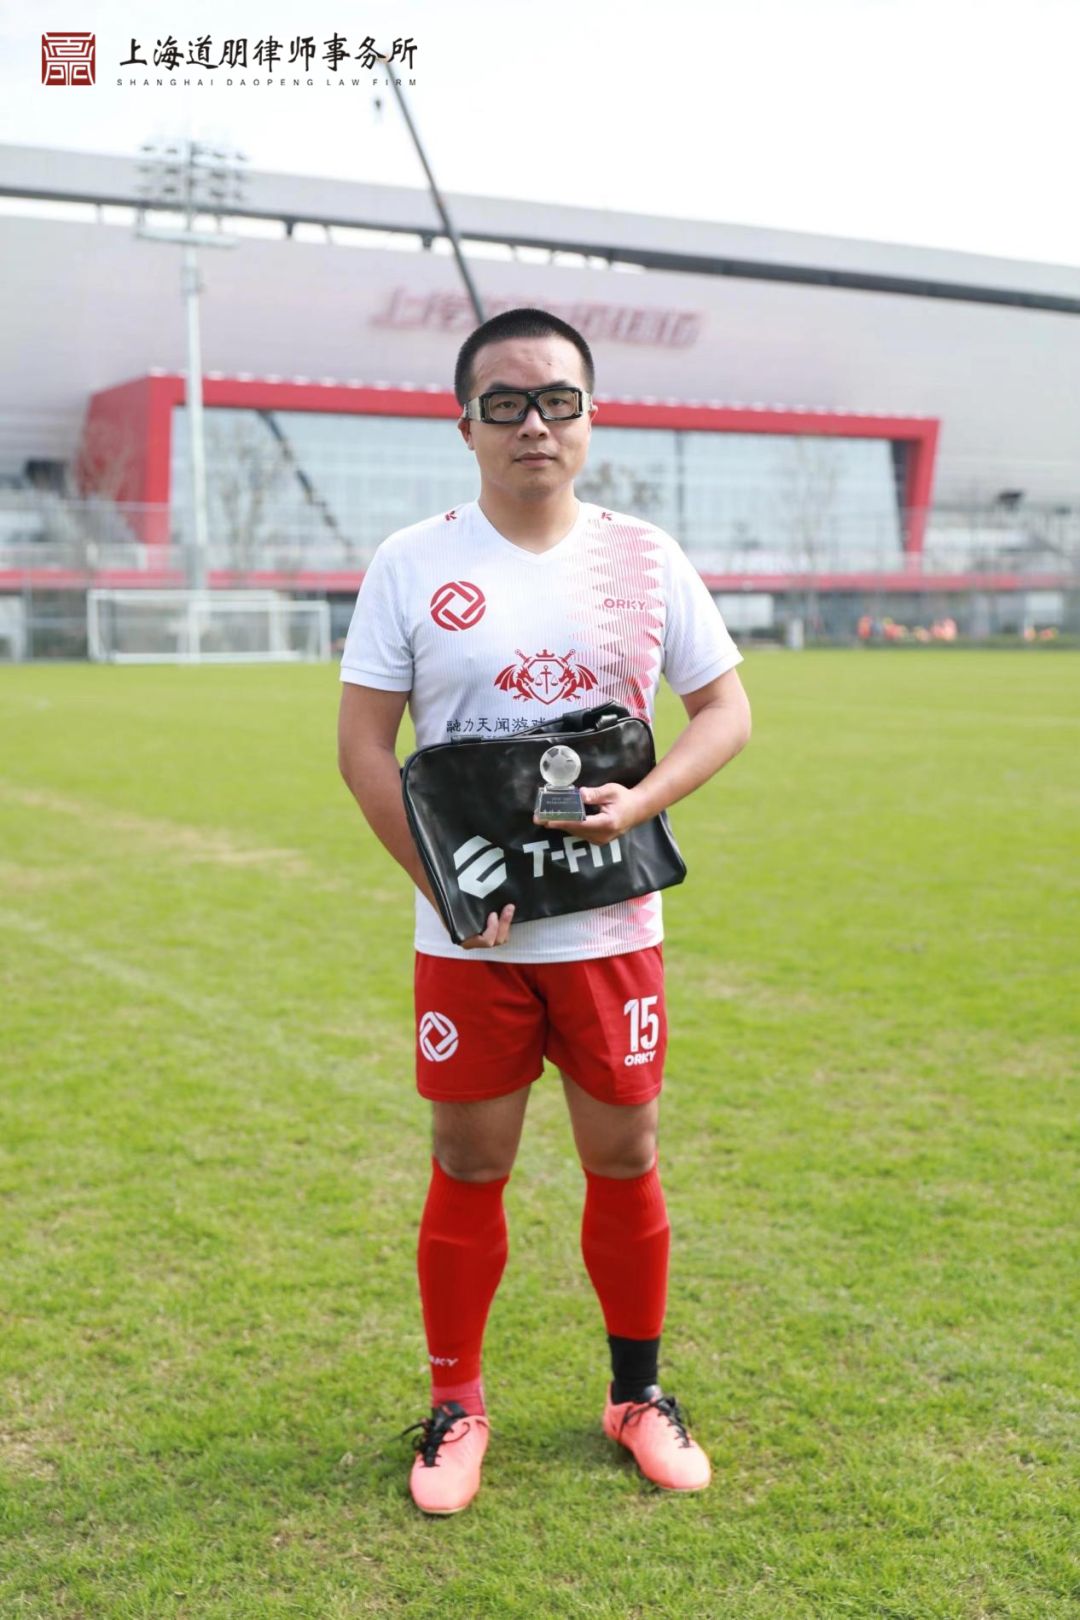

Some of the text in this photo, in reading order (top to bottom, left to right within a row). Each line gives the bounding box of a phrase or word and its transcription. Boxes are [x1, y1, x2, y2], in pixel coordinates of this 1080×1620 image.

[603, 598, 646, 611] ORKY
[623, 995, 659, 1053] 15
[624, 1050, 656, 1067] ORKY
